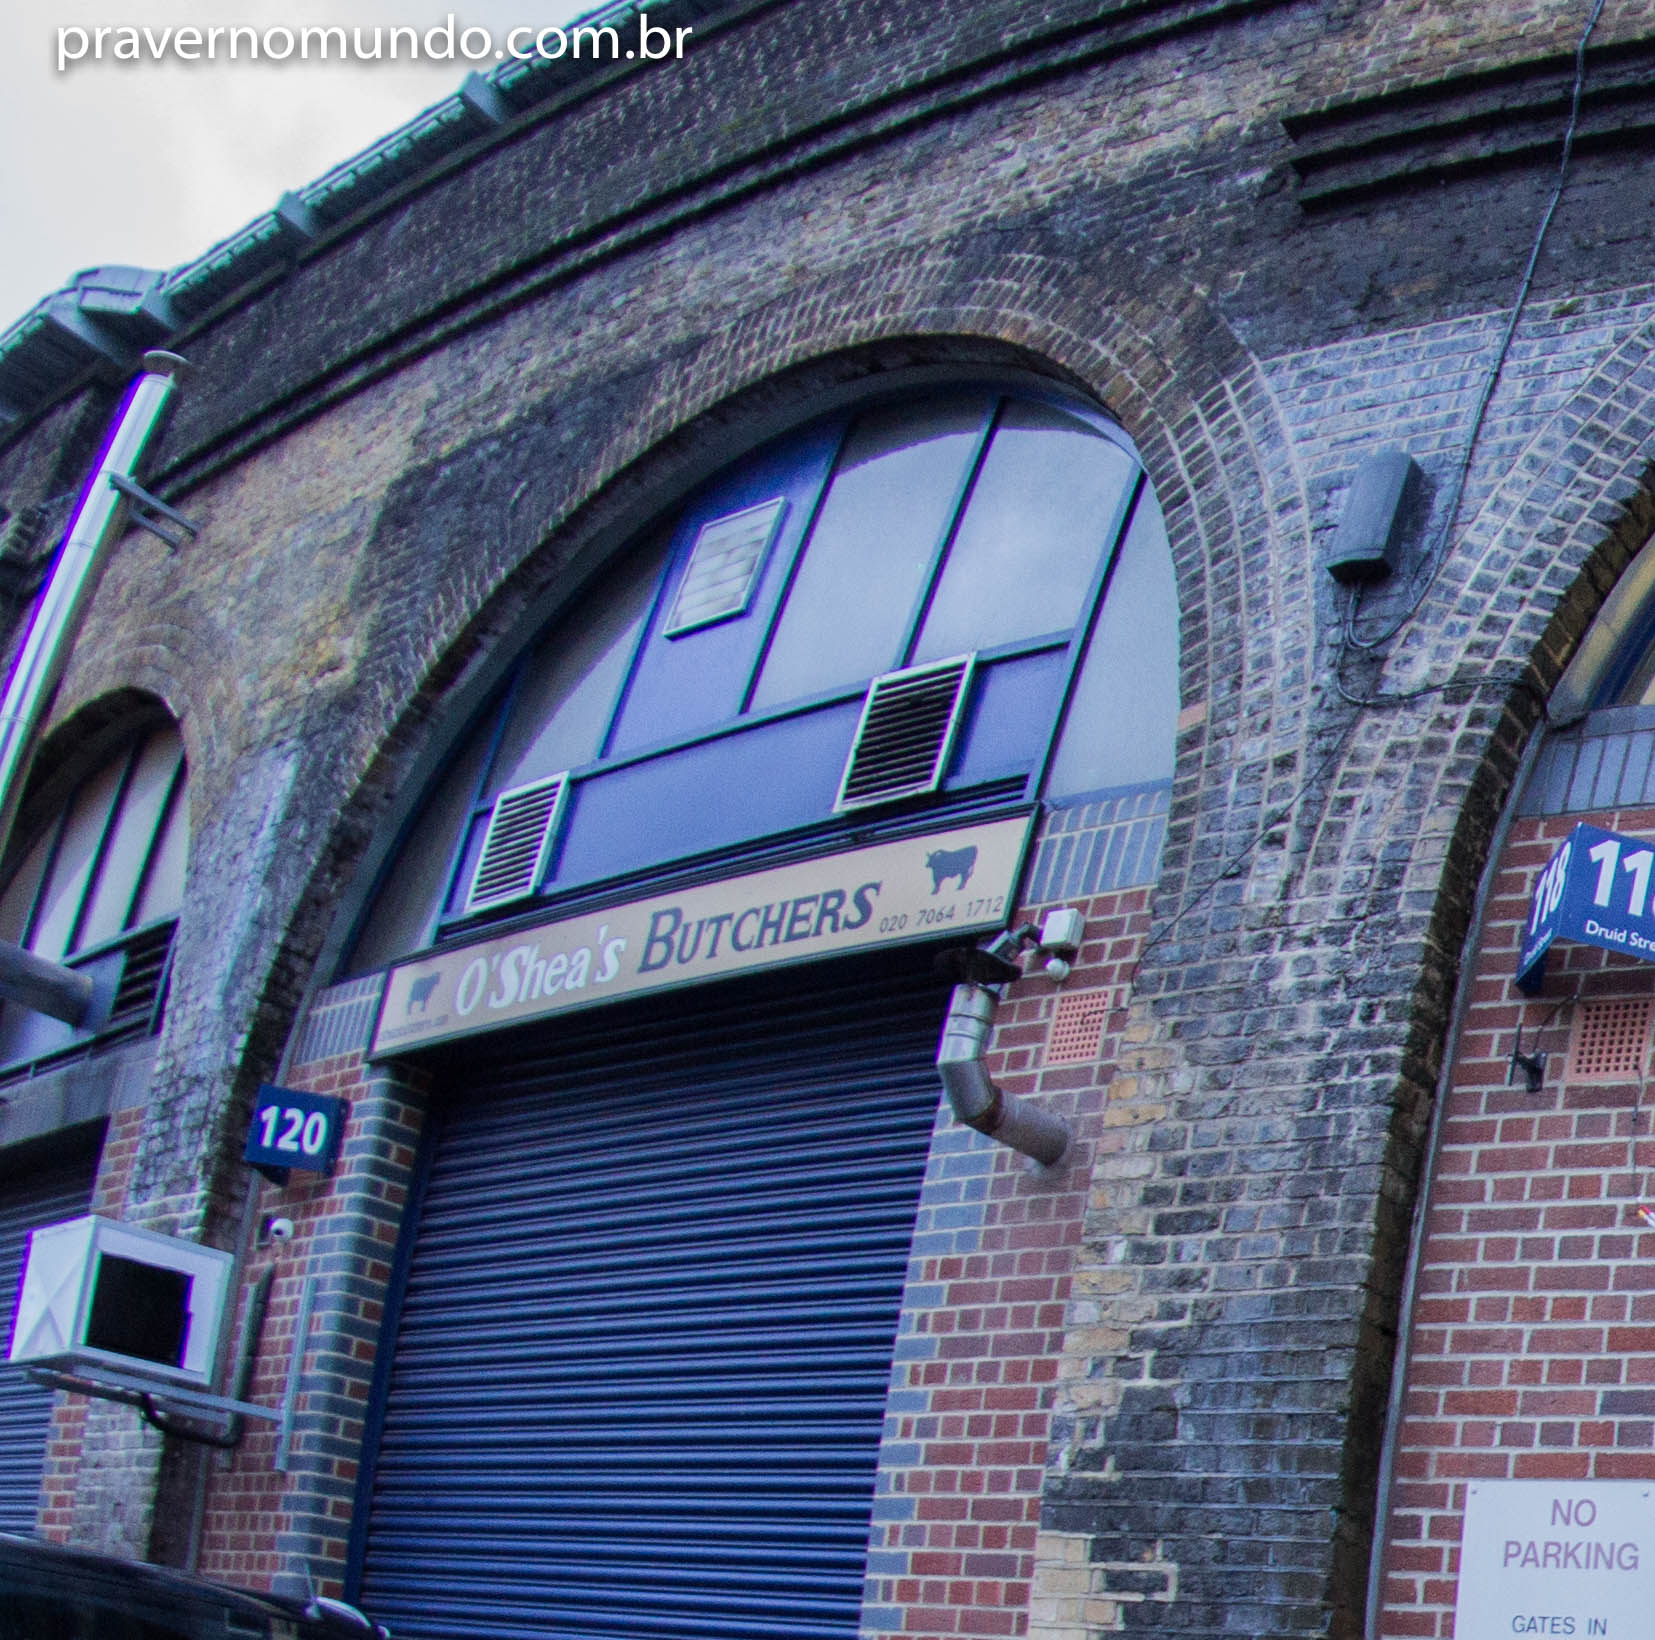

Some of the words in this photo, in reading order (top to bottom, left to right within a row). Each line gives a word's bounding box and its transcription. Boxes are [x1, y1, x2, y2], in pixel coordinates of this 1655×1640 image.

[1530, 841, 1572, 936] 118
[879, 913, 909, 934] 020
[918, 905, 956, 926] 7064
[967, 895, 1004, 918] 1712
[1585, 919, 1627, 943] Druid
[456, 924, 628, 1016] O'Shea's
[259, 1105, 328, 1154] 120
[1551, 1499, 1597, 1527] NO
[1503, 1540, 1640, 1570] PARKING
[1512, 1615, 1576, 1635] GATES
[1587, 1618, 1607, 1636] IN
